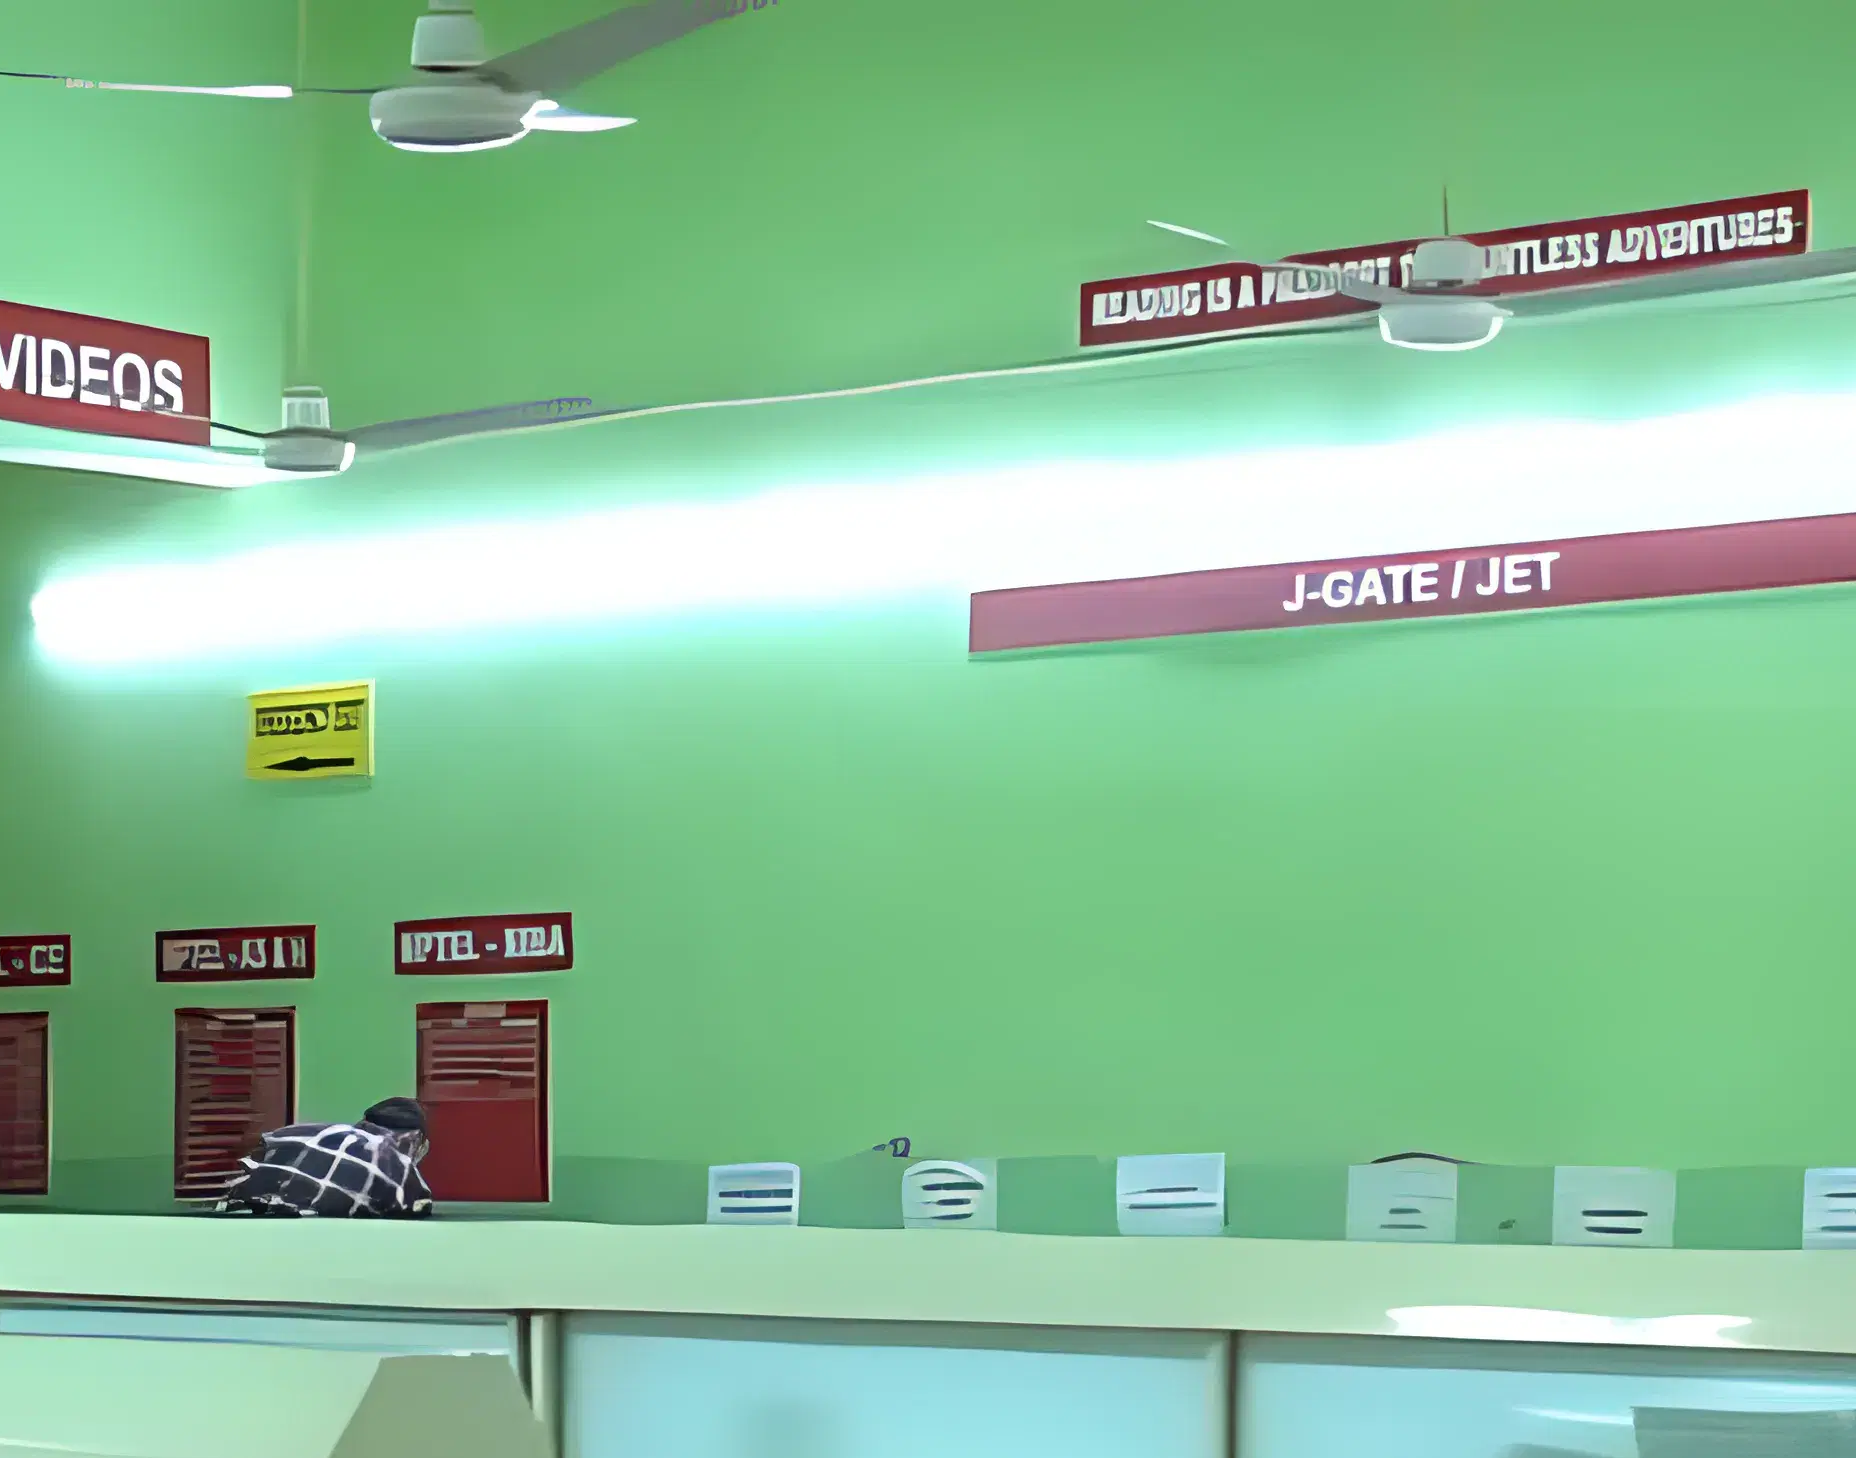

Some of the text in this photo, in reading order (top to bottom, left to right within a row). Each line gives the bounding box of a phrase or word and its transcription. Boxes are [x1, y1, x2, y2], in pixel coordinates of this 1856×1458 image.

[1283, 551, 1560, 611] J-GATE / JET
